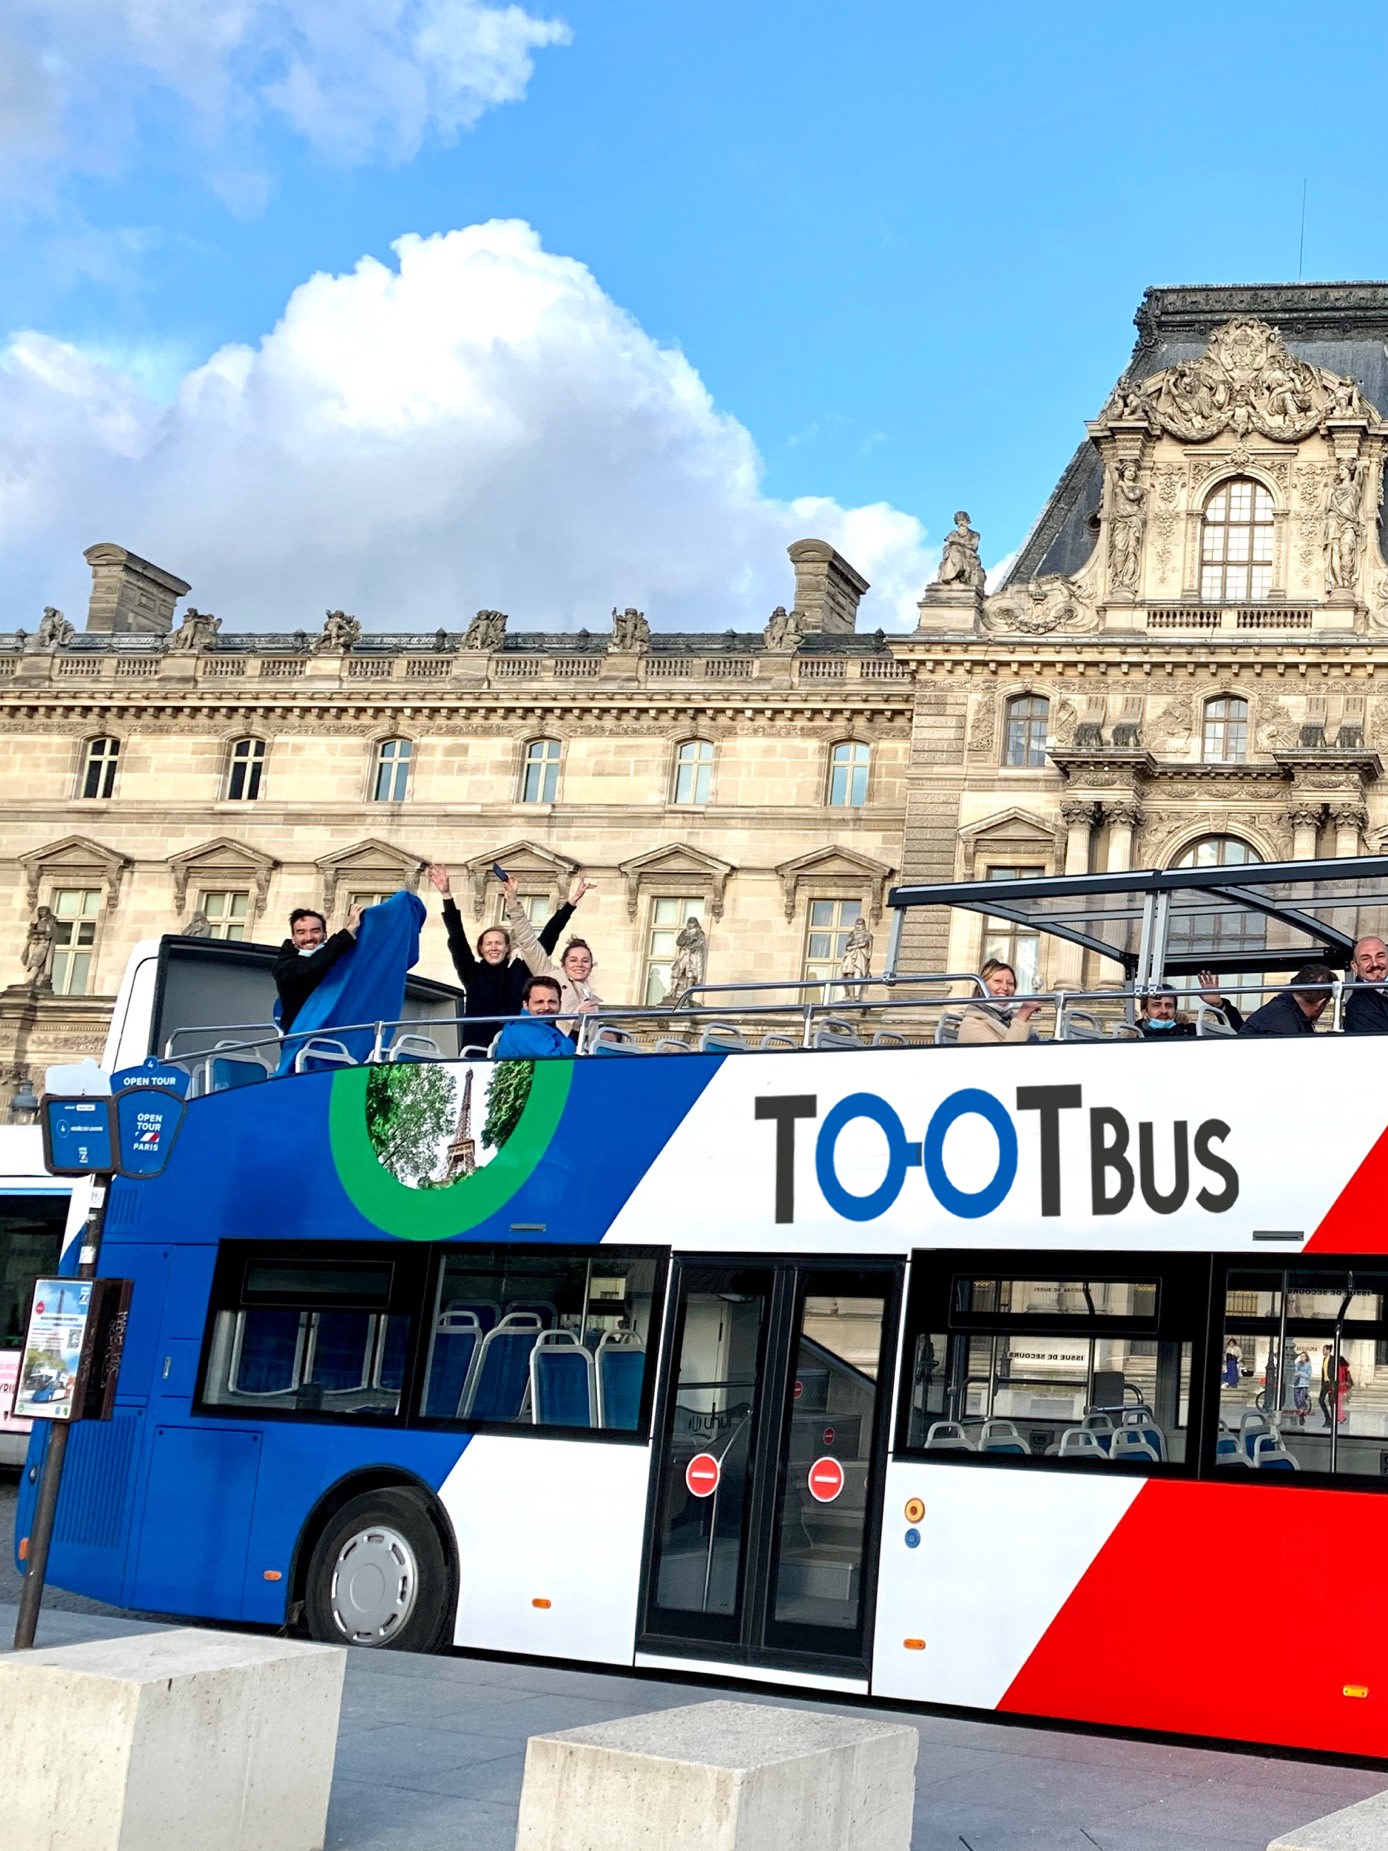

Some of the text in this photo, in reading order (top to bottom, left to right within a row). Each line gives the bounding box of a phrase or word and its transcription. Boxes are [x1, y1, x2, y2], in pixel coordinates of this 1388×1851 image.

[123, 1077, 176, 1086] OPEN TOUR
[137, 1113, 162, 1122] OPEN
[136, 1122, 161, 1131] TOUR
[133, 1143, 159, 1151] PARIS
